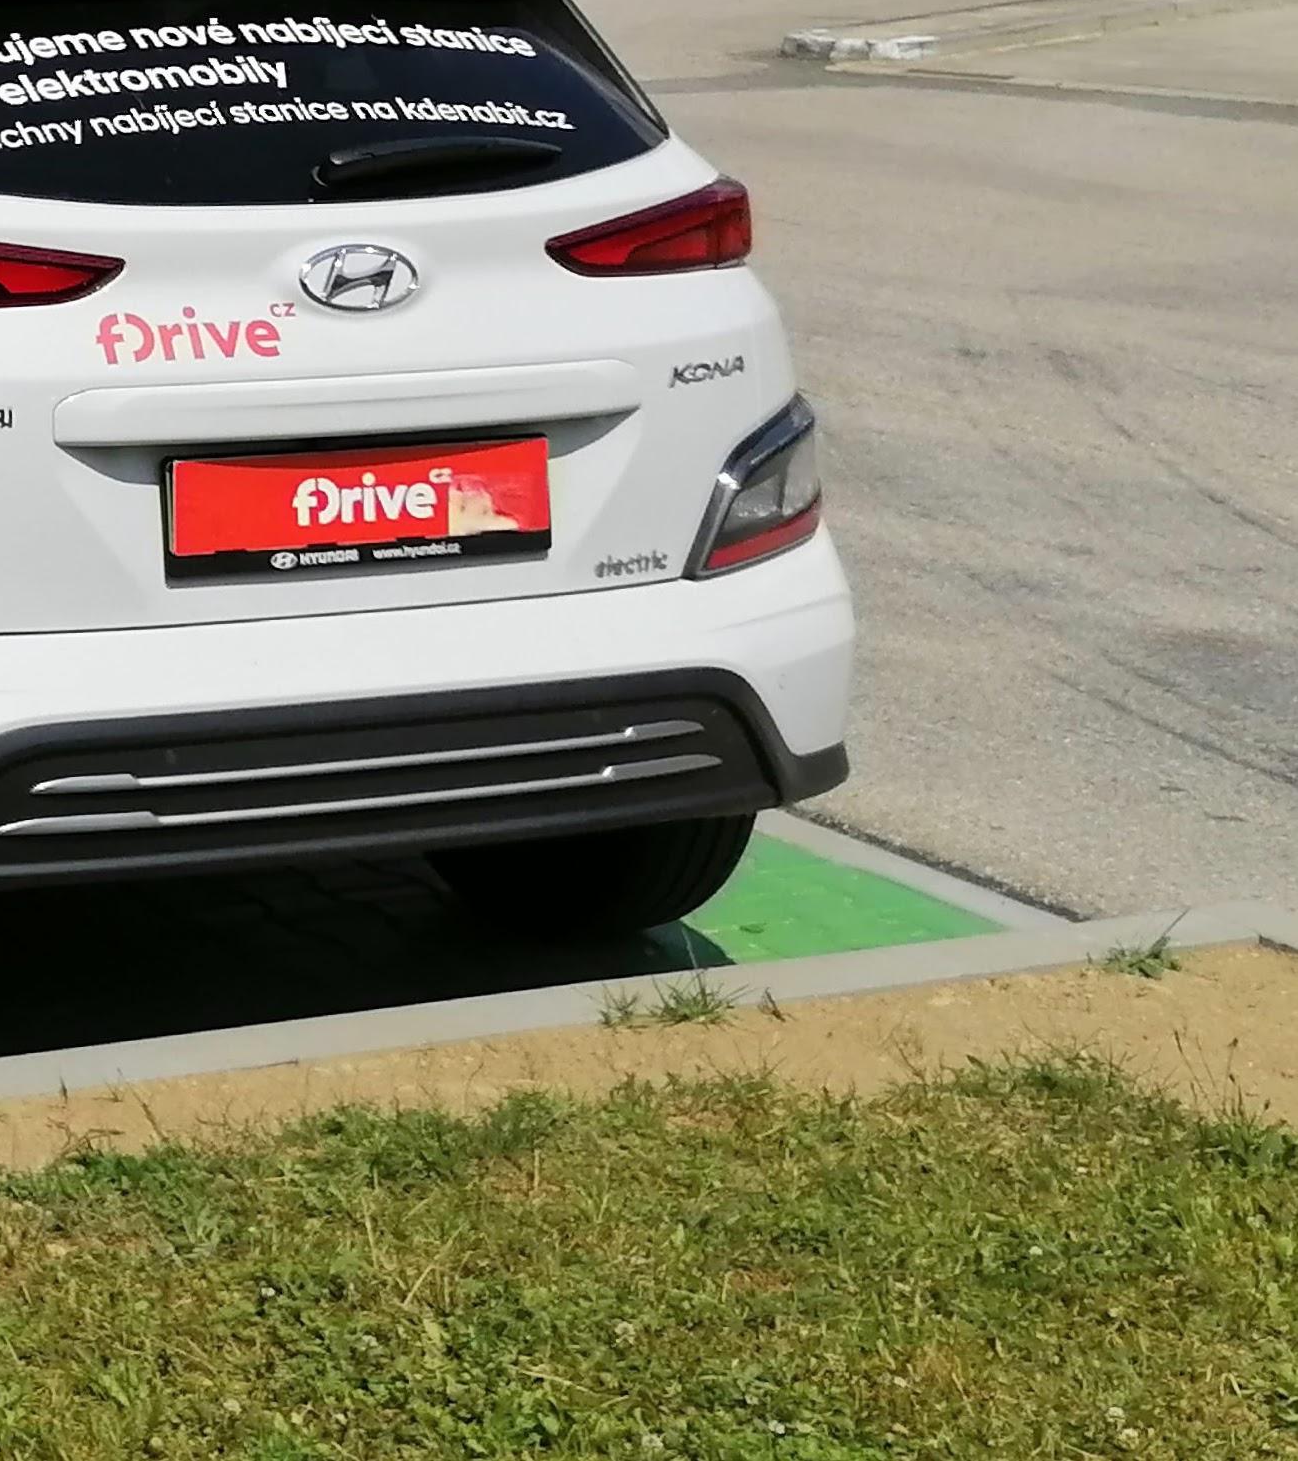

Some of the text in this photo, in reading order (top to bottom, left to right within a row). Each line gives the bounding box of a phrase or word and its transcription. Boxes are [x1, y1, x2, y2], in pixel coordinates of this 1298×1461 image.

[129, 18, 237, 49] nové
[238, 17, 399, 48] nabíjecí
[399, 24, 537, 57] stanice
[90, 100, 226, 134] nabíjecí
[229, 97, 349, 126] stanice
[352, 102, 399, 121] na
[395, 97, 577, 129] kdenabit.cz
[667, 356, 745, 388] KONA
[299, 549, 360, 565] HYUNDAI
[594, 550, 668, 578] electric
